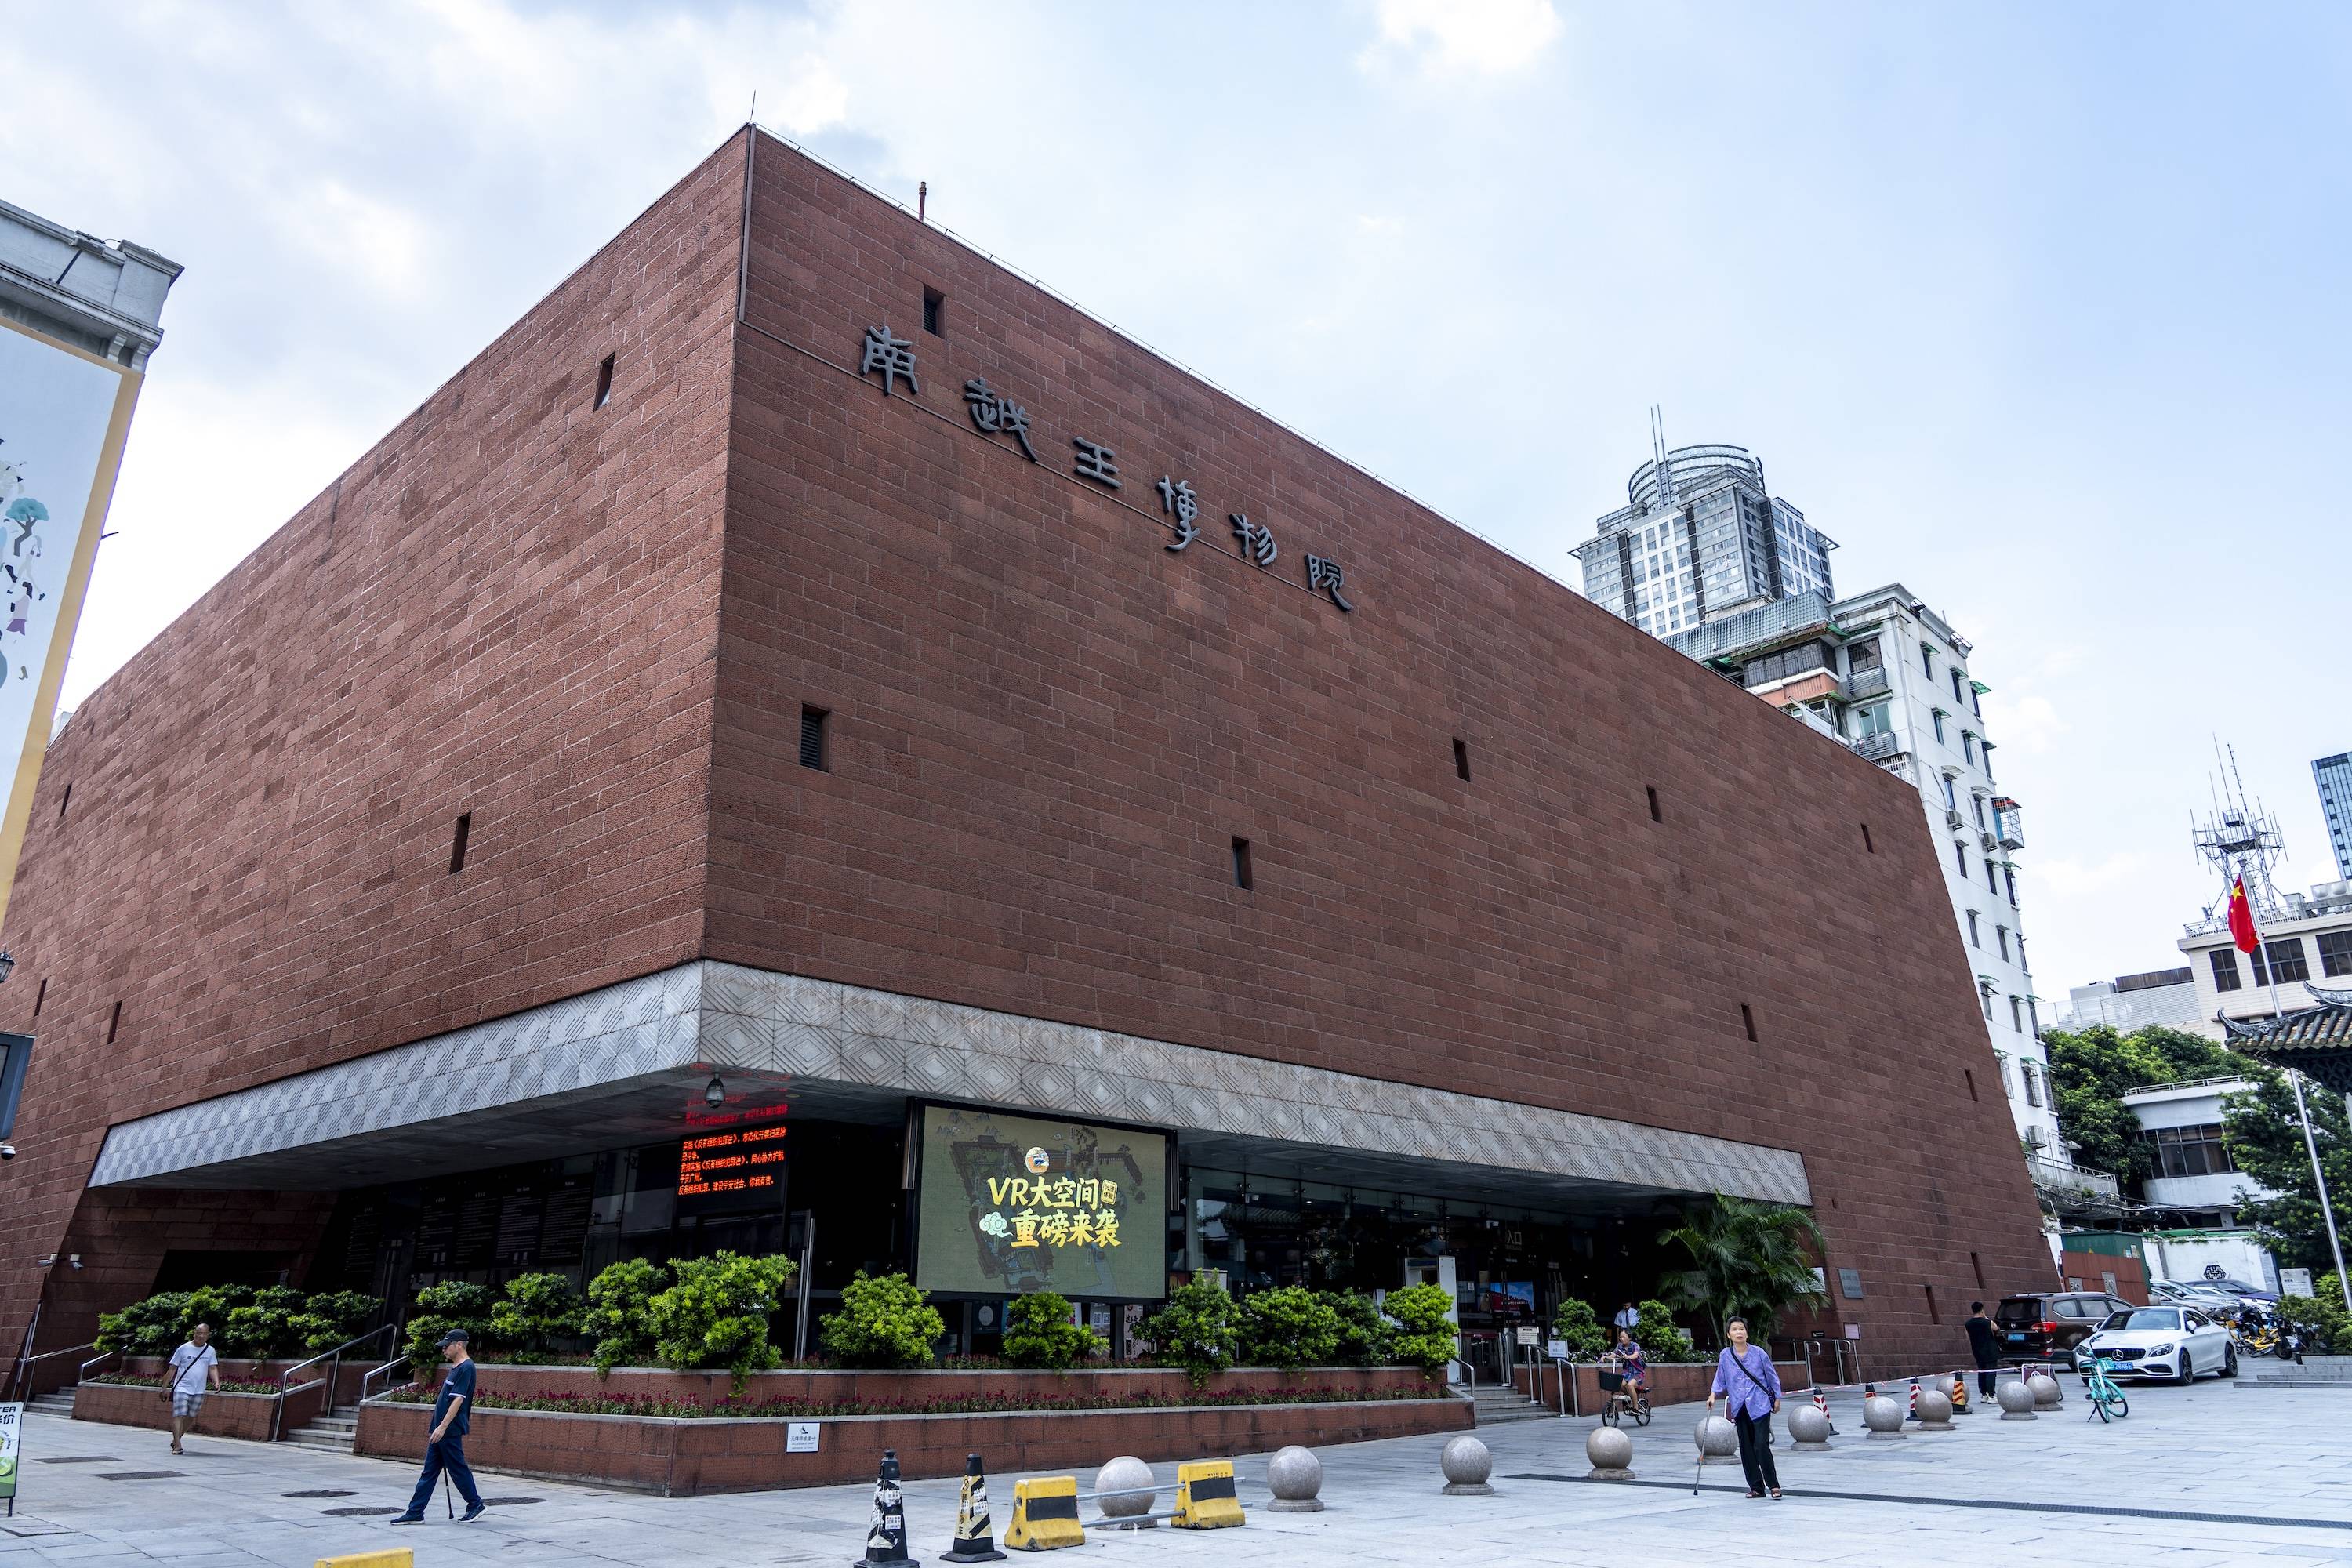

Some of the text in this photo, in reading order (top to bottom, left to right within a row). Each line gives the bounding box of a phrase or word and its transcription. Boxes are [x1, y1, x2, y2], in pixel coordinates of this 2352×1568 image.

[862, 325, 1353, 612] 南越王博物院
[1010, 1207, 1123, 1248] 重磅来袭
[1507, 1229, 1522, 1245] 入口
